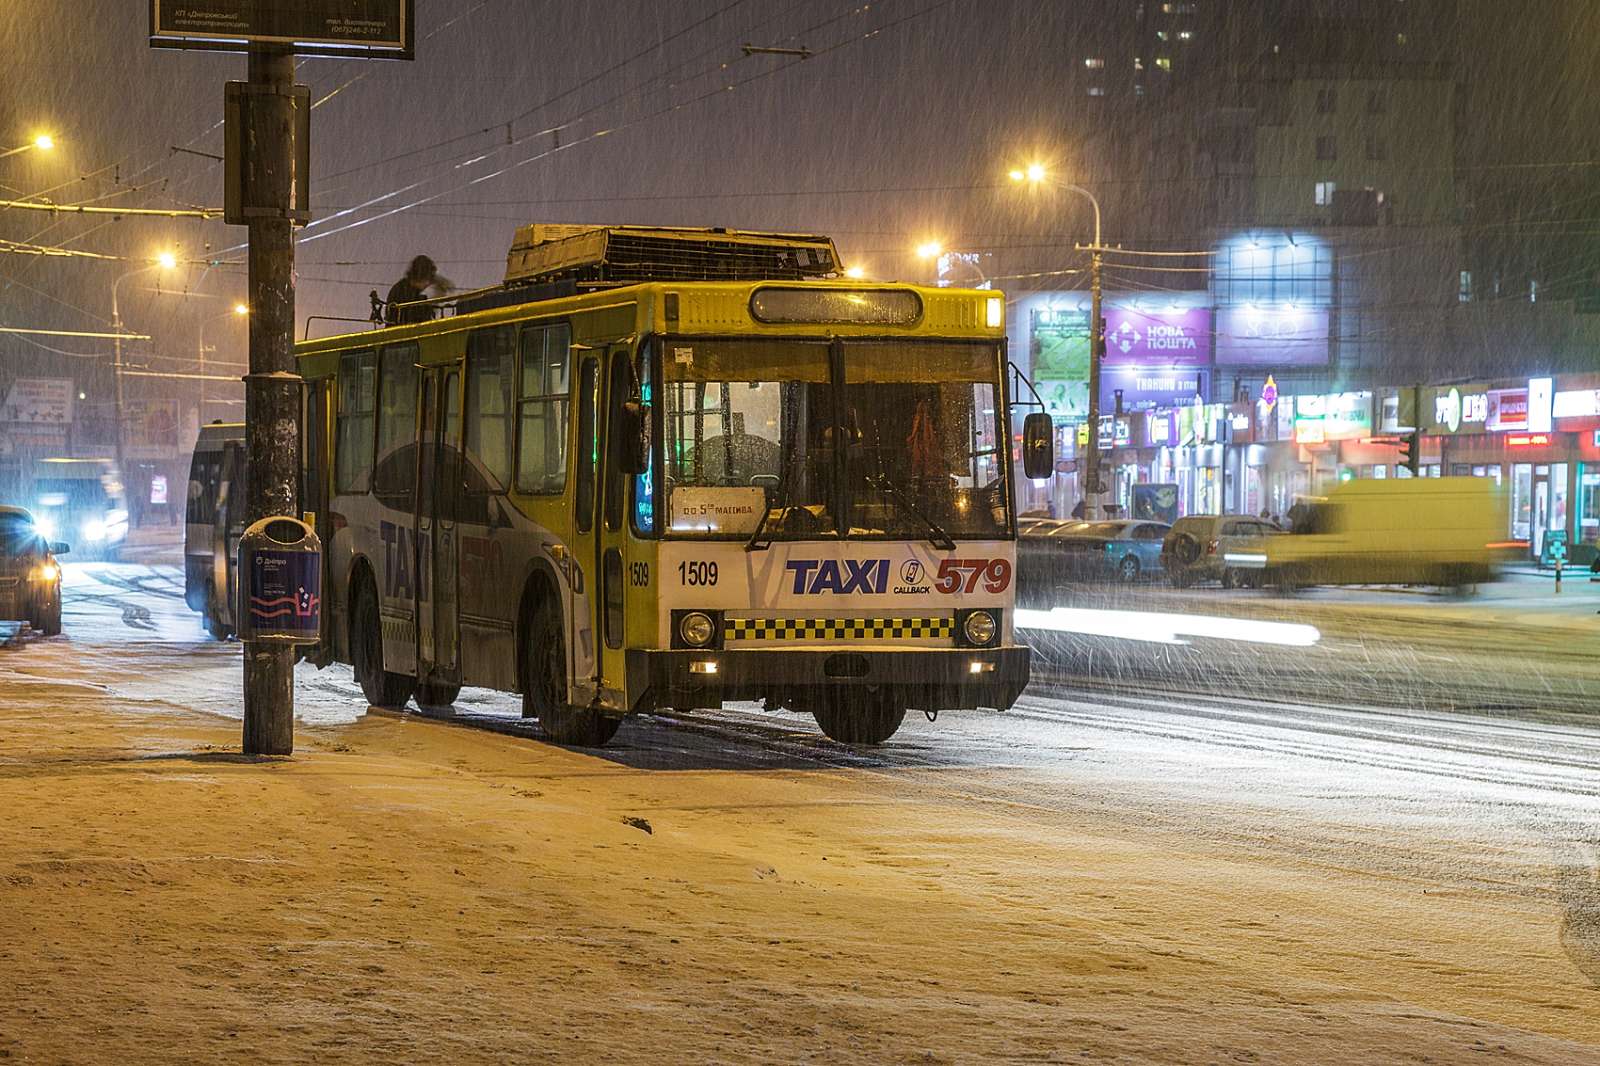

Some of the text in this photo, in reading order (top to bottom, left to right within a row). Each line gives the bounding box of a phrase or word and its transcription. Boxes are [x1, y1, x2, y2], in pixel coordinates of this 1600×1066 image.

[1147, 326, 1185, 338] НОВА
[1147, 338, 1197, 349] ПОШТА
[629, 562, 649, 587] 1509
[678, 560, 718, 586] 1509
[786, 559, 891, 594] TAXI
[934, 558, 1012, 593] 579
[893, 586, 931, 594] CALLBACK
